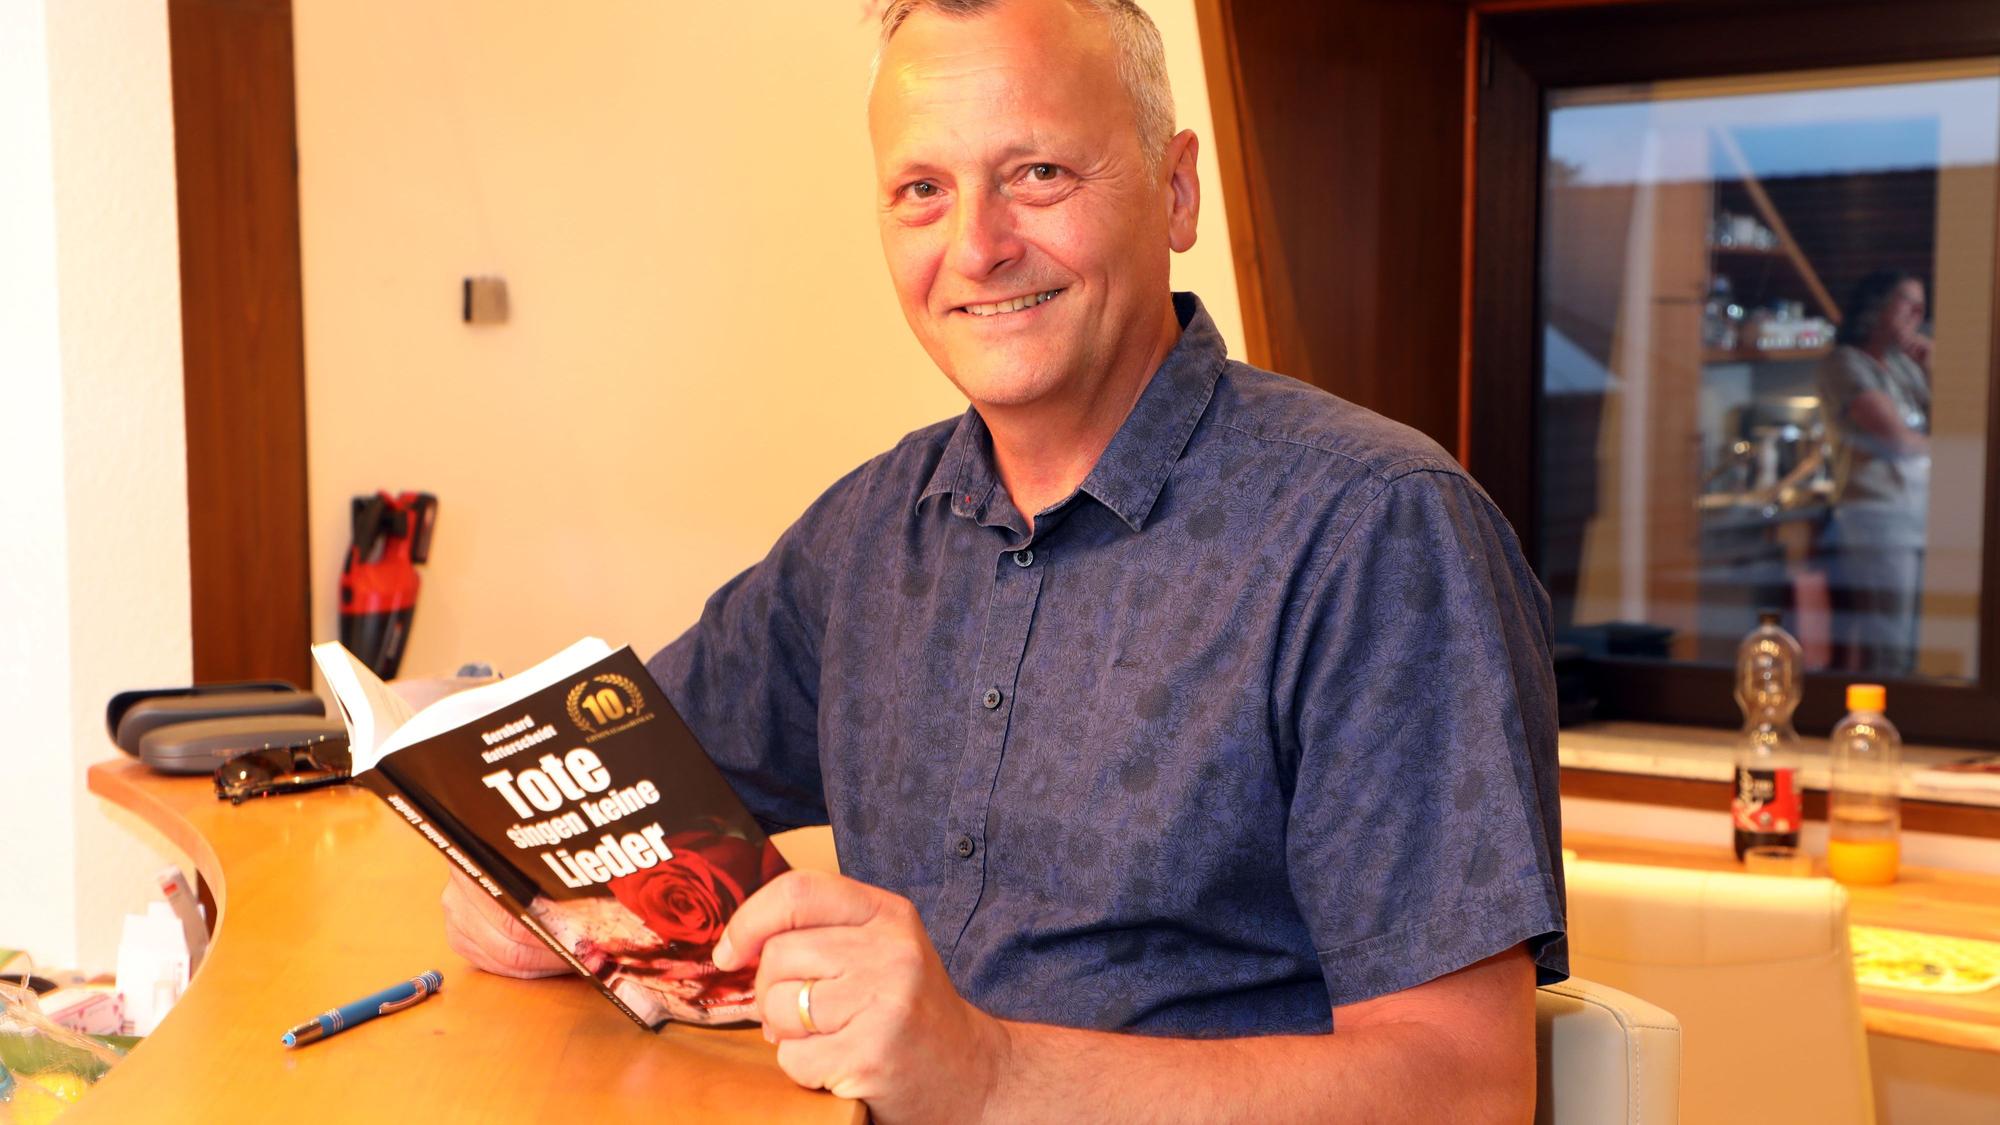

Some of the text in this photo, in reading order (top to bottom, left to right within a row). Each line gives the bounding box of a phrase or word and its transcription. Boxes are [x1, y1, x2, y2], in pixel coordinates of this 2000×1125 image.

[481, 747, 611, 819] Tote
[506, 780, 660, 849] singen keine
[540, 822, 673, 888] Lieder
